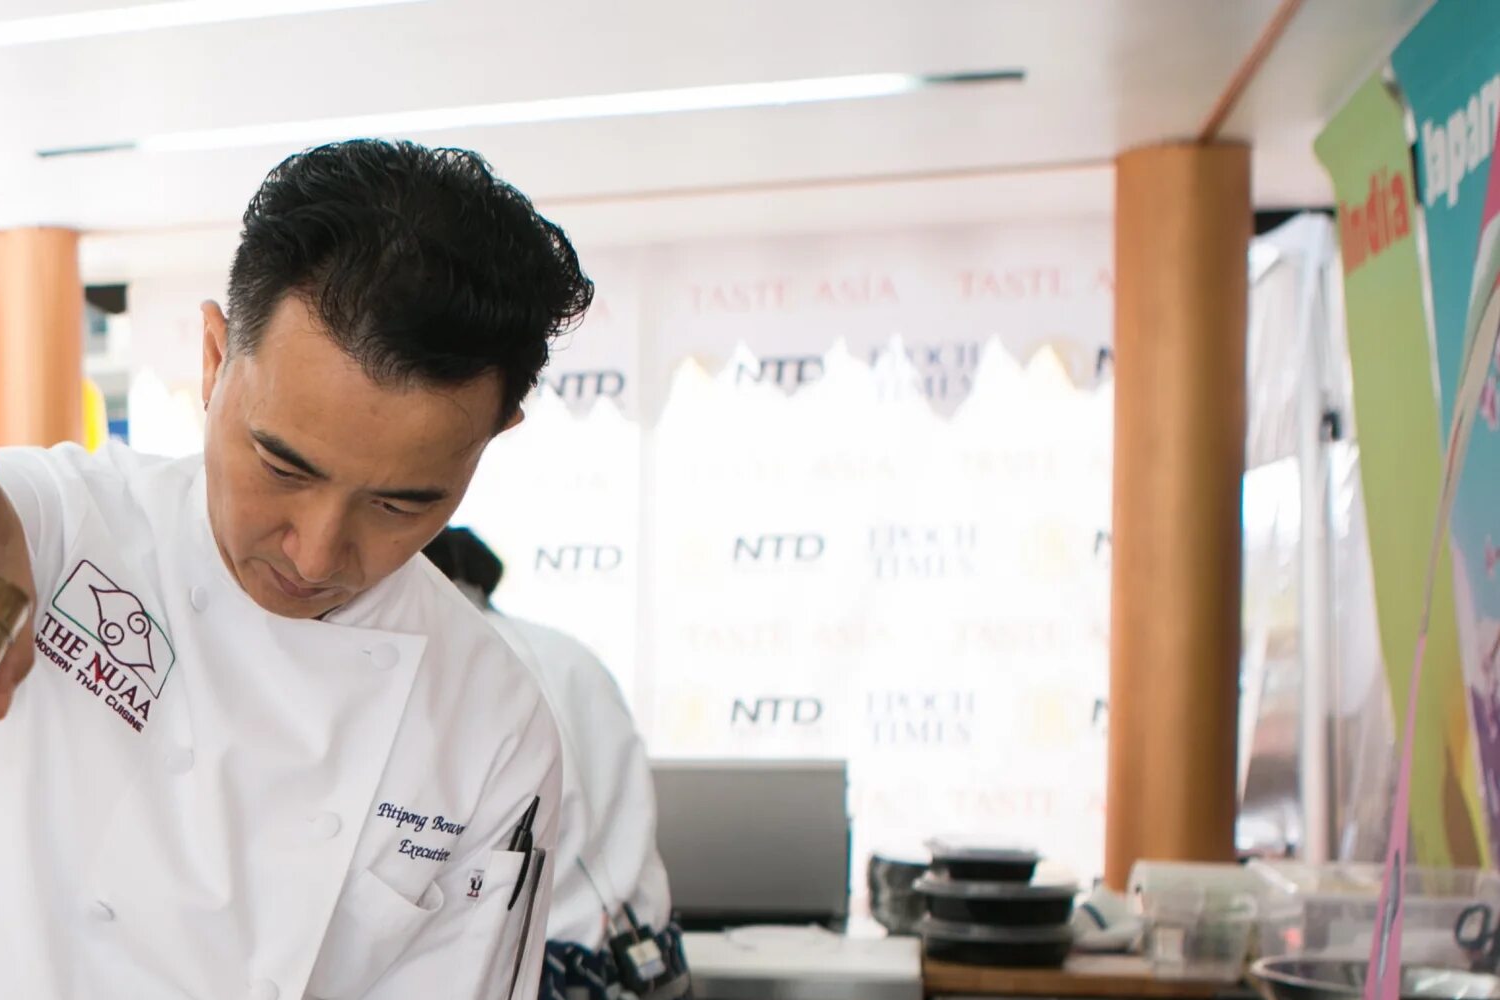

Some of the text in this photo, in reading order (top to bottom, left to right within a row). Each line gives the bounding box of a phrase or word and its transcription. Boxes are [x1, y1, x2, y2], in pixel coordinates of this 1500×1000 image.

[1421, 72, 1500, 209] Japan
[1340, 165, 1411, 278] India
[691, 276, 791, 312] TASTE
[958, 268, 1066, 302] TASTE
[538, 369, 626, 400] NTD
[736, 355, 825, 390] NTD
[534, 545, 623, 572] NTD
[733, 532, 826, 562] NTD
[35, 633, 144, 733] MODERN THAI CUISINE
[41, 612, 151, 722] THE NUAA
[730, 696, 824, 726] NTD
[377, 802, 429, 832] Pitipong
